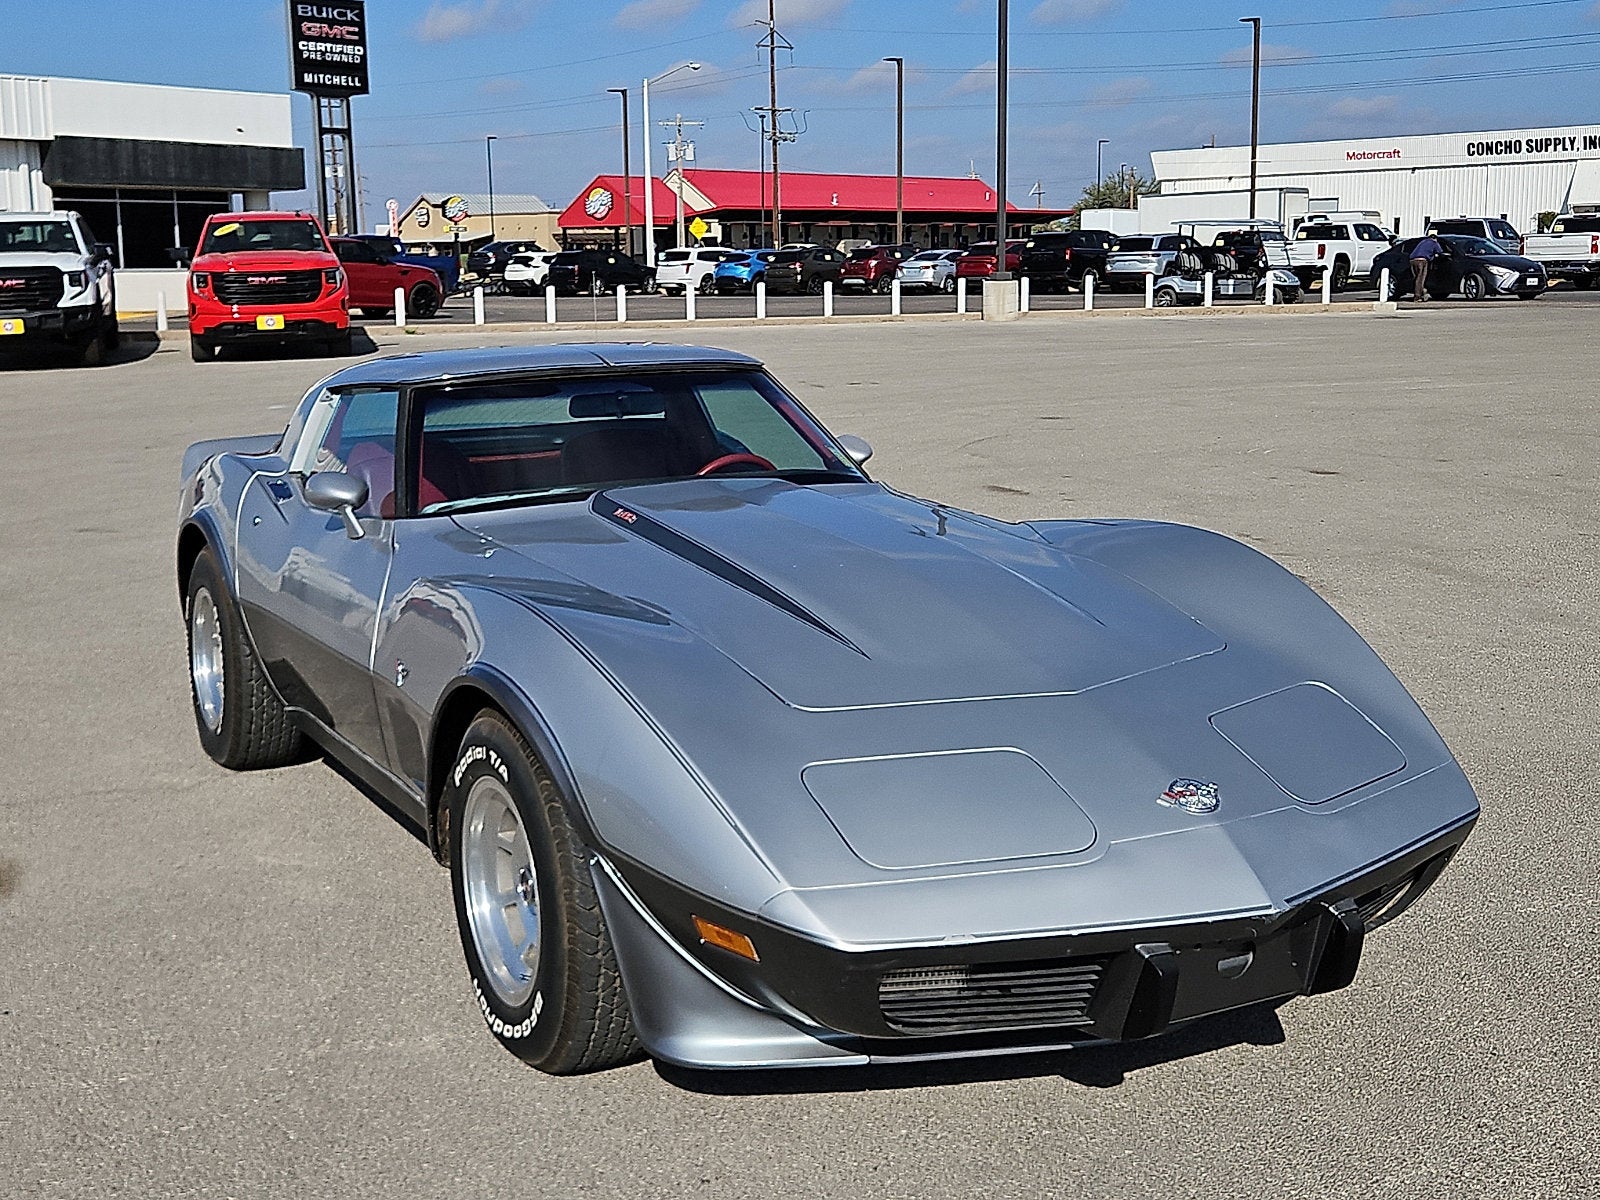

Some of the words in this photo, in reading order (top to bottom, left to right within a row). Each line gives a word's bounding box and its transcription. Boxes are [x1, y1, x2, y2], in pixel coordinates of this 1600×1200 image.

[297, 4, 360, 21] BUICK
[301, 22, 359, 39] GMC
[298, 41, 364, 55] CERTIFIED
[302, 51, 361, 63] PRE-OWNED
[304, 73, 361, 87] MITCHELL
[1466, 142, 1522, 157] CONCHO
[1525, 136, 1580, 154] SUPPLY,
[1582, 134, 1600, 151] IN
[1345, 149, 1401, 161] Motorcraft
[247, 276, 287, 285] GMC
